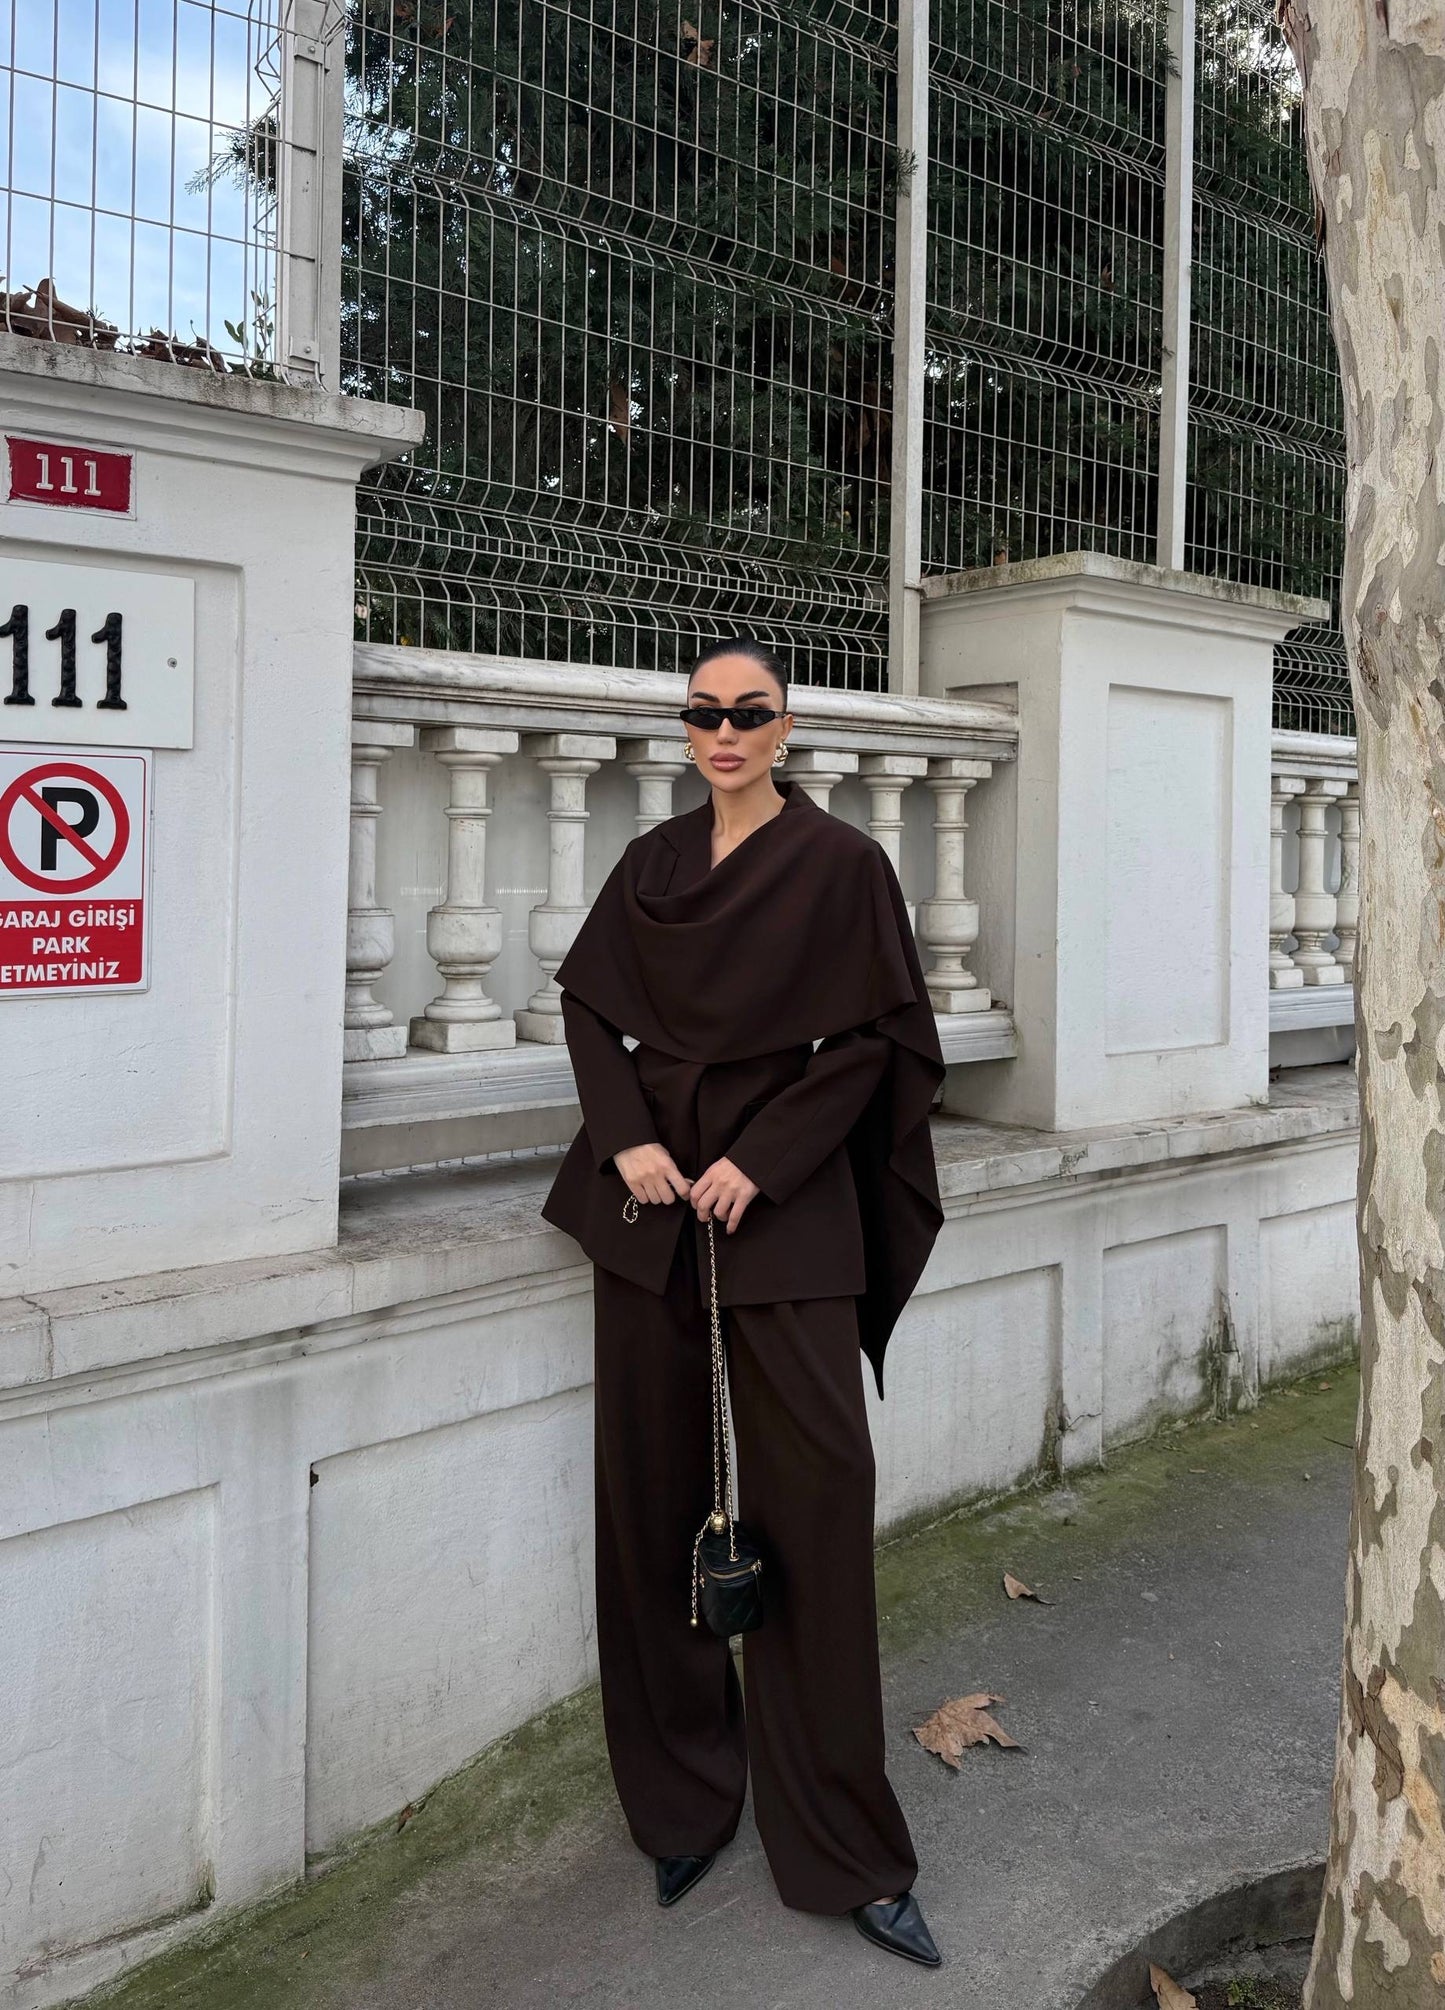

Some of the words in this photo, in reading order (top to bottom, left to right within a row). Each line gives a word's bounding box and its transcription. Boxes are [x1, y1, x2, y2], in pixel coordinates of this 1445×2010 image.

[36, 453, 102, 496] 111
[0, 604, 128, 710] 111
[41, 786, 100, 871] P
[0, 910, 61, 929] ARAJ
[68, 904, 135, 931] GİRİŞİ
[32, 936, 91, 955] PARK
[1, 957, 120, 983] ETMEYİNİZ
